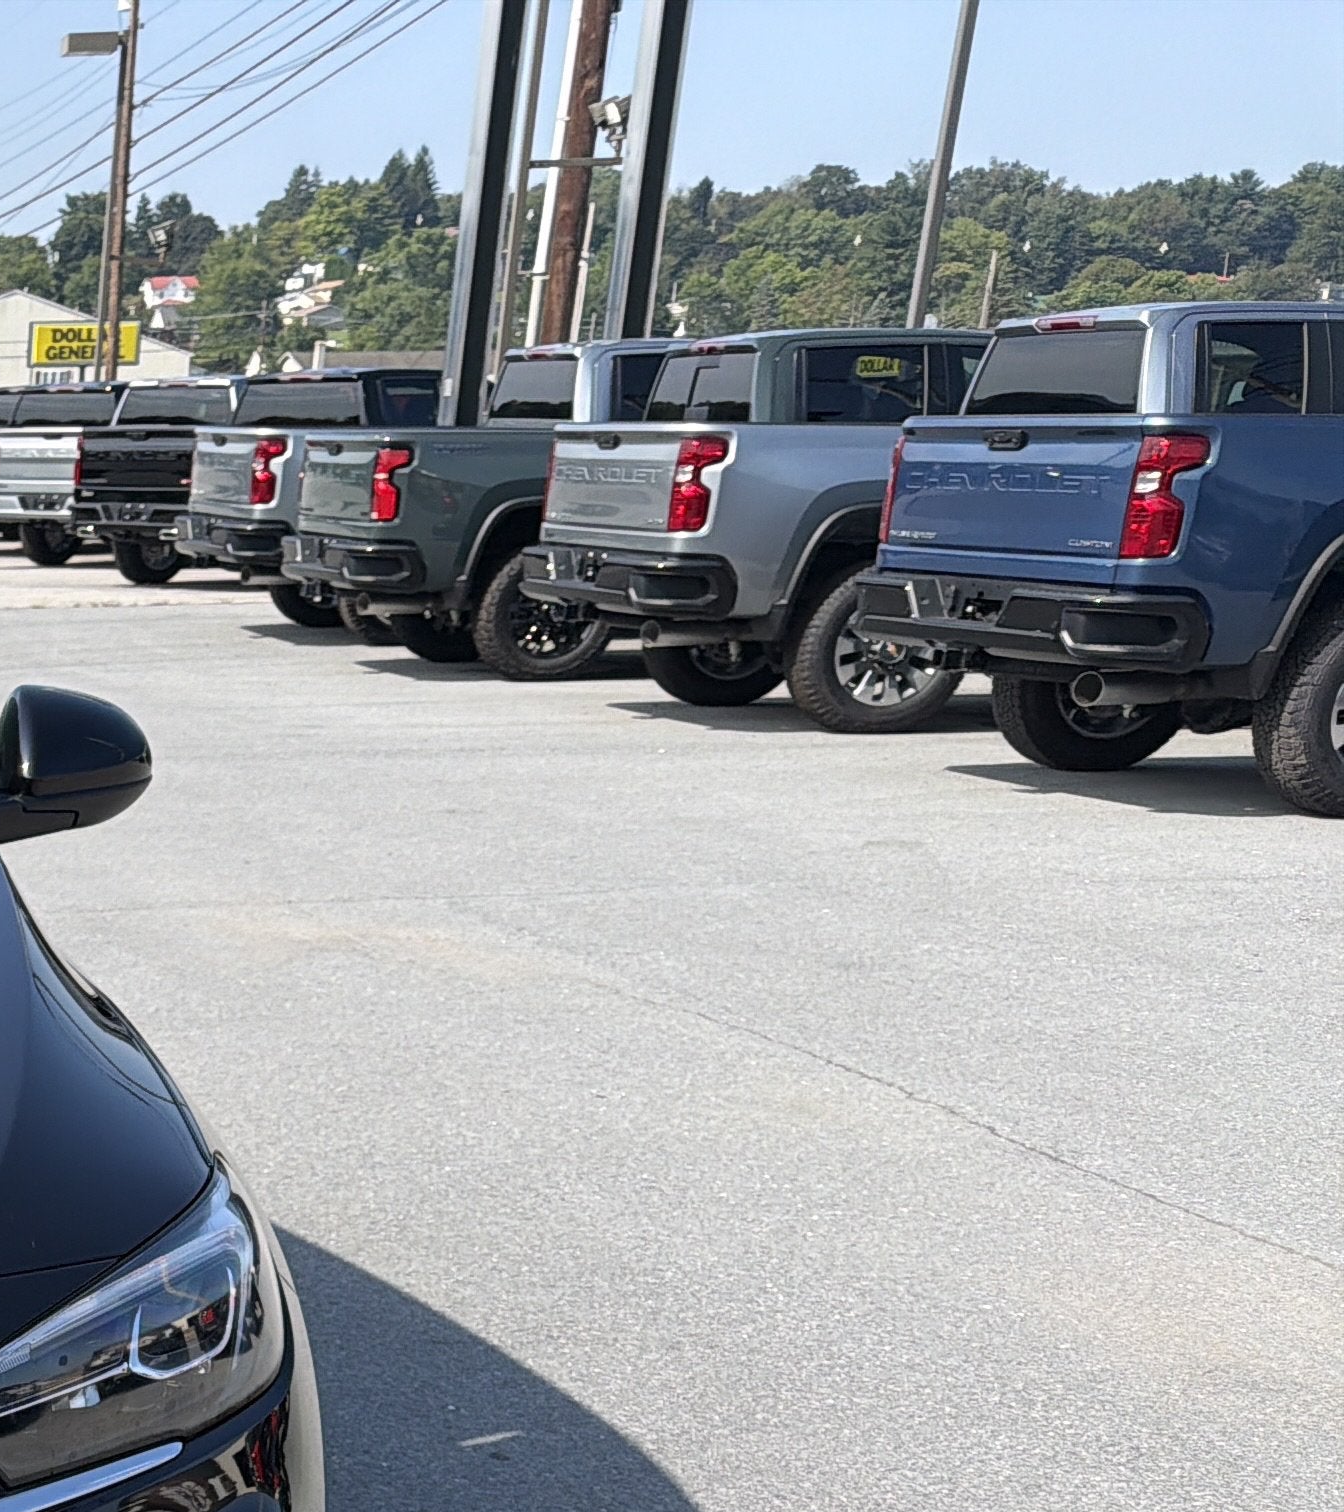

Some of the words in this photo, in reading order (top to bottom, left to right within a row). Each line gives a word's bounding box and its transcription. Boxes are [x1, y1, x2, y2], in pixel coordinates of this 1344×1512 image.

[51, 327, 125, 343] DOLL
[45, 345, 125, 360] GENE
[906, 470, 1110, 494] CHEVROLET
